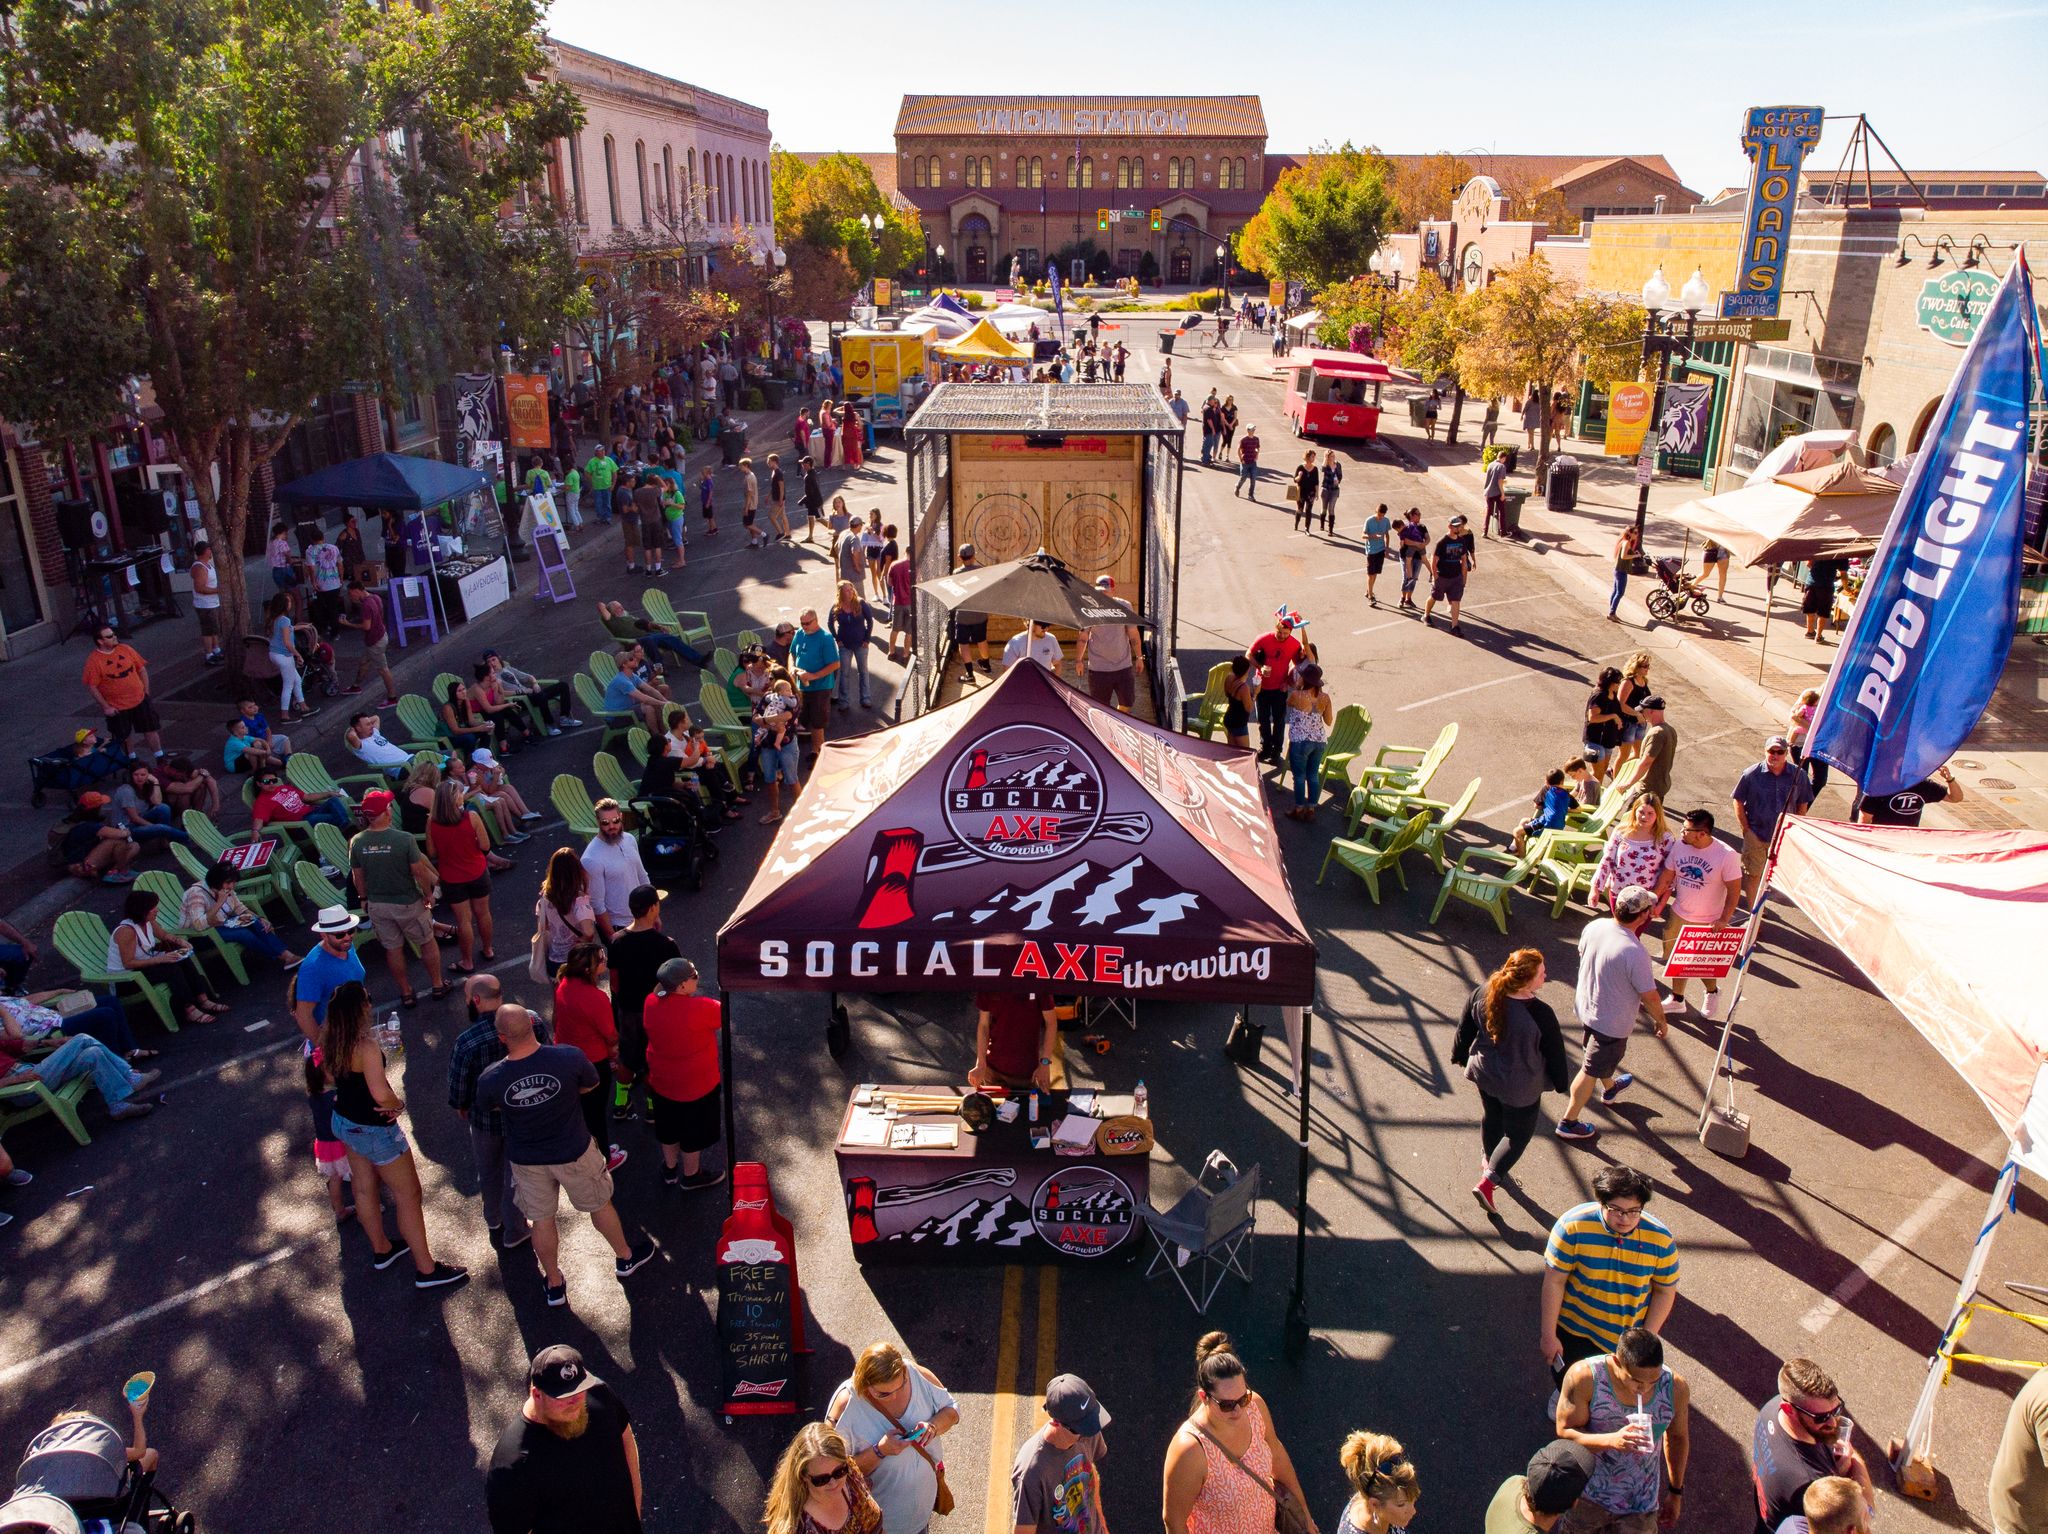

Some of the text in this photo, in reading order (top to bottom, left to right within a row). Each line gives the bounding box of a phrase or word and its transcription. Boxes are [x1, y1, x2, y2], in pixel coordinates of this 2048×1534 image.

[976, 109, 1188, 133] UNION STATION
[1751, 125, 1820, 137] HOUSE
[1717, 323, 1753, 340] HOUSE
[1856, 409, 2020, 722] BUD LIGHT
[1081, 607, 1127, 618] GUINNESS
[956, 791, 1092, 810] SOCIAL
[1897, 794, 1919, 809] TF
[984, 815, 1062, 842] AXE
[988, 841, 1055, 856] throwing
[1676, 855, 1713, 874] CALIFORNIA
[1686, 931, 1722, 939] SUPPORT
[1677, 940, 1739, 951] PATIENTS
[760, 940, 1272, 989] SOCIAL AXE throwing
[512, 1076, 545, 1092] O'NEILL
[1039, 1208, 1128, 1223] SOCIAL
[1059, 1224, 1109, 1245] AXE
[1061, 1242, 1104, 1254] throwing
[730, 1265, 777, 1282] FREE
[744, 1281, 766, 1291] AXE
[746, 1304, 763, 1318] 10
[730, 1343, 747, 1352] GET
[760, 1341, 786, 1350] FREE
[736, 1353, 777, 1368] SHIRT
[736, 1383, 782, 1393] Budweiser
